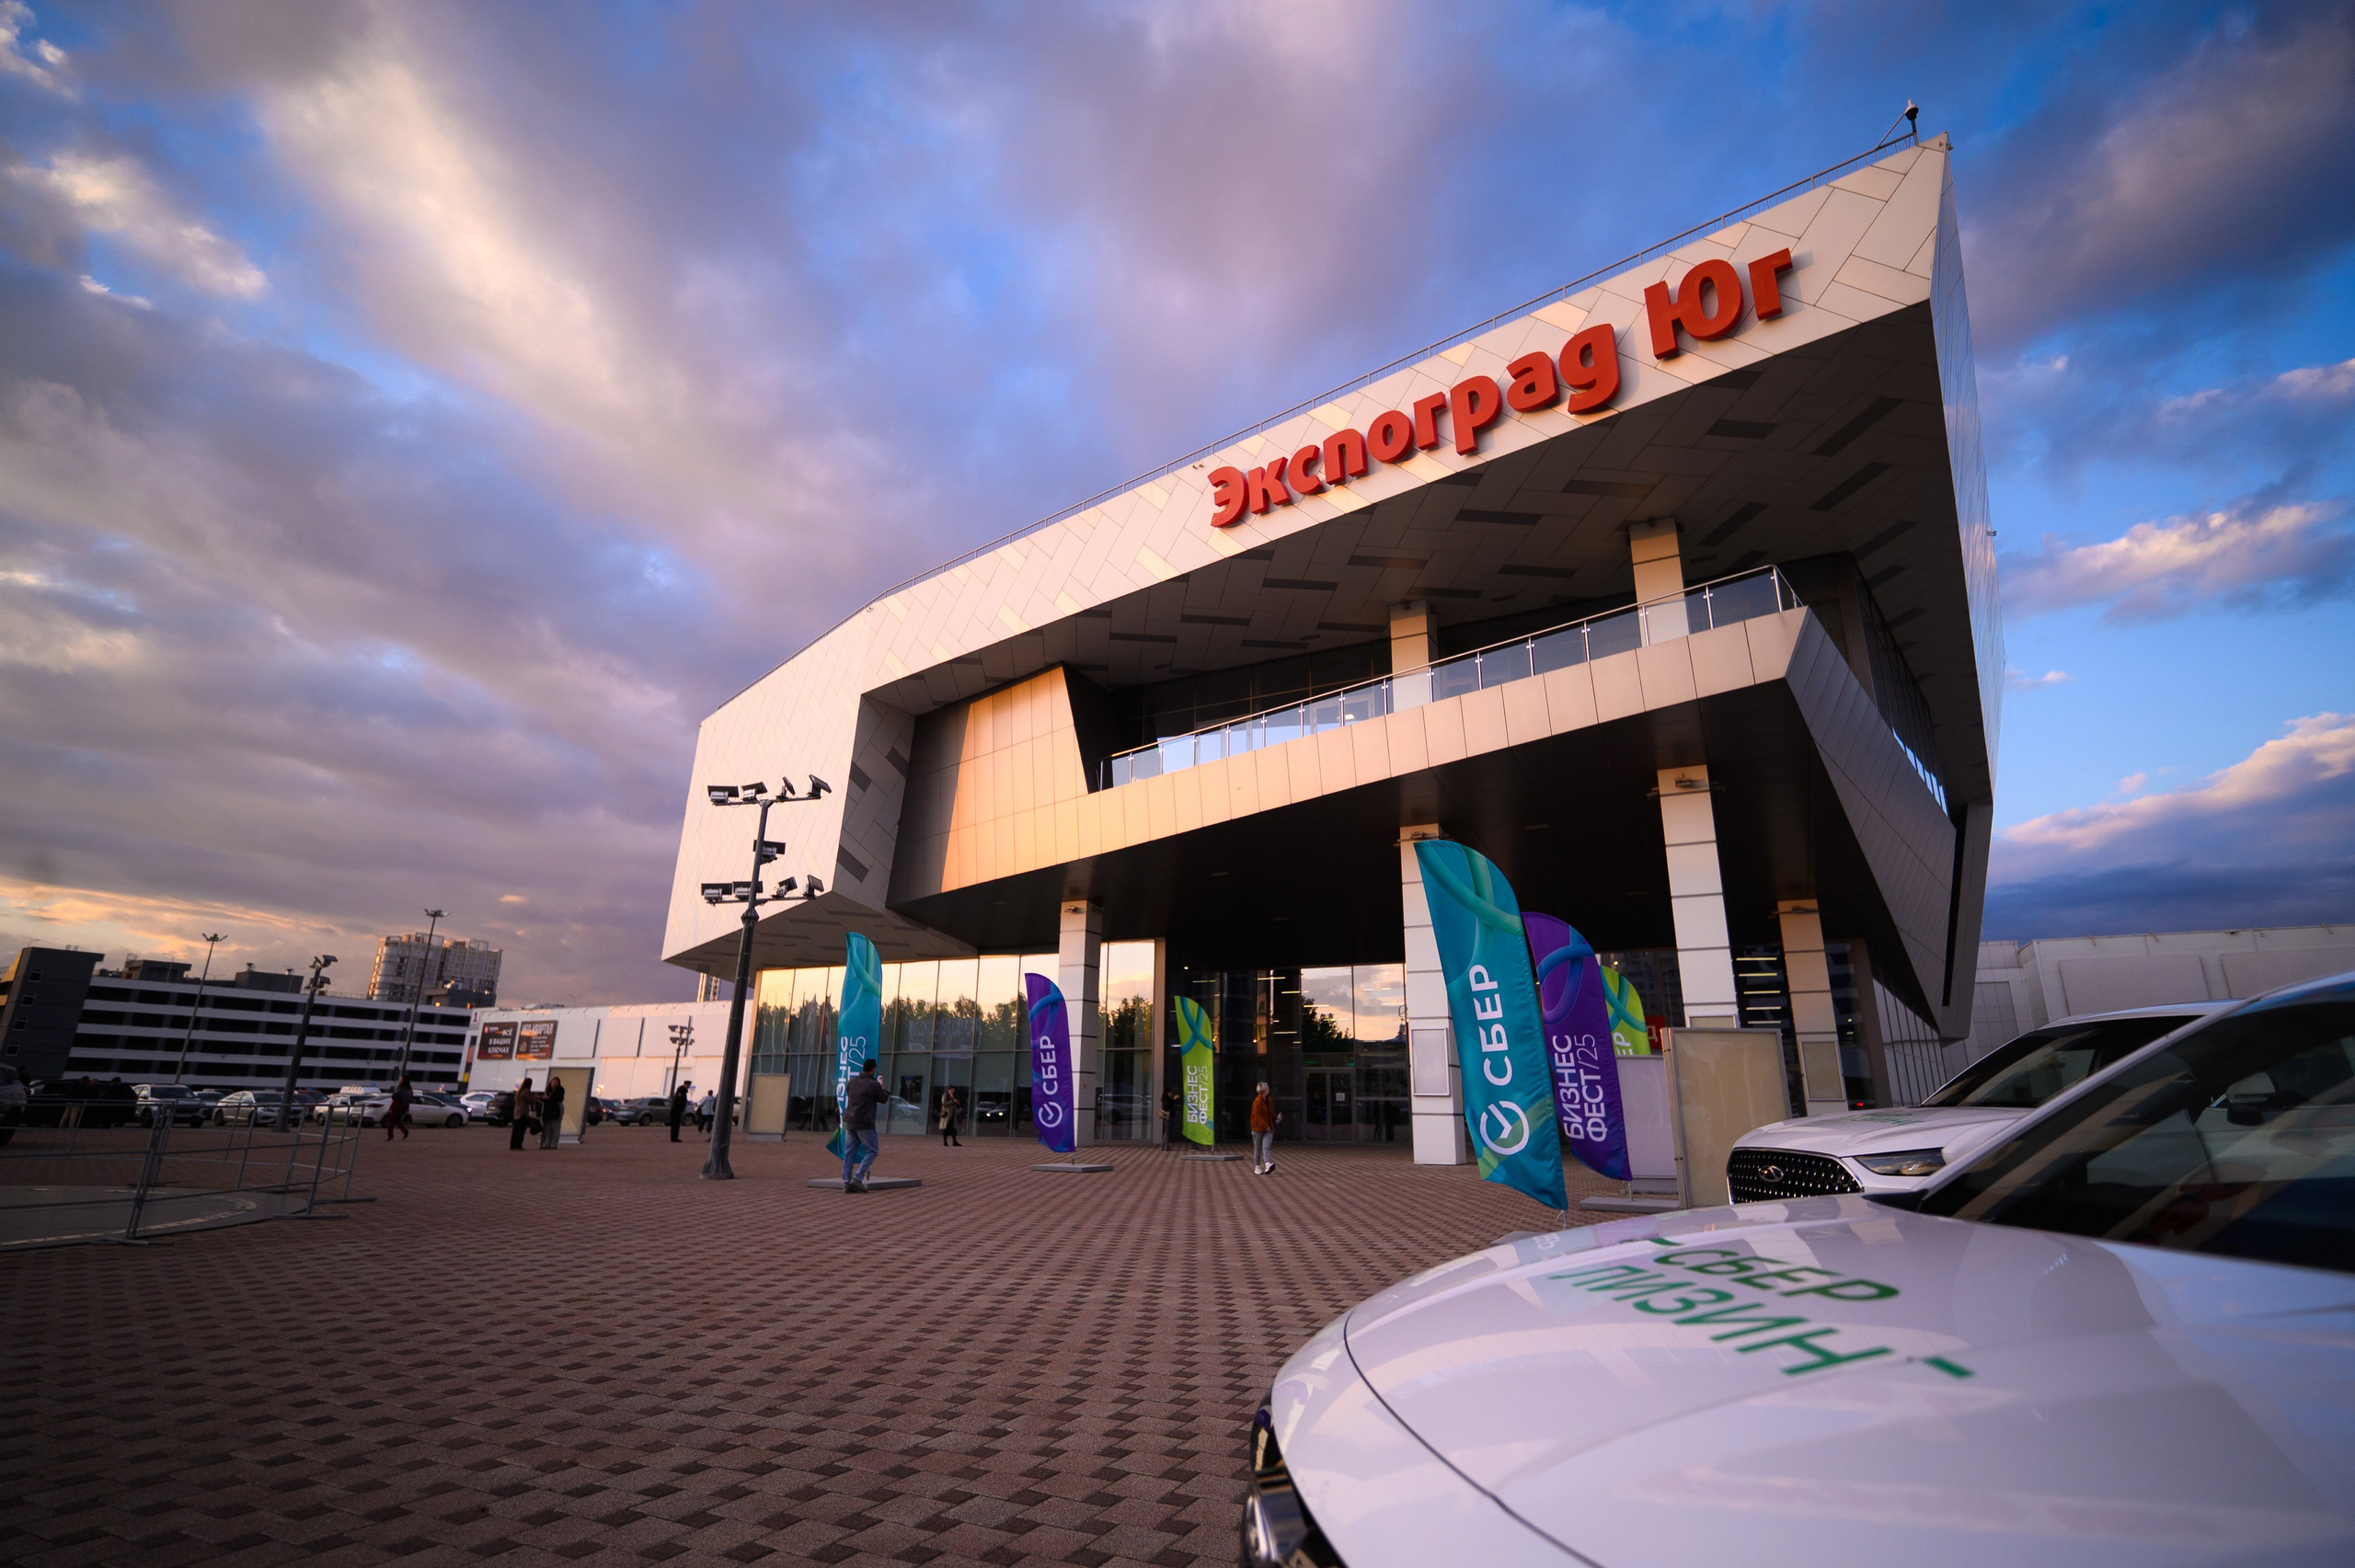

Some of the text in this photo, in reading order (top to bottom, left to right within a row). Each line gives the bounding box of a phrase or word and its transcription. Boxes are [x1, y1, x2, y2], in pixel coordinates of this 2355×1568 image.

[1207, 248, 1793, 527] Экспоград Юг
[473, 1013, 477, 1023] 1
[1469, 965, 1512, 1086] СБЕР
[1040, 1036, 1058, 1095] СБЕР
[1187, 1065, 1199, 1124] БИЗНЕС
[1553, 1035, 1584, 1139] БИЗНЕС
[1574, 1034, 1607, 1142] ФЕСТ/25
[1199, 1066, 1209, 1125] ФЕСТ/25
[1653, 1250, 1901, 1301] СБЕР
